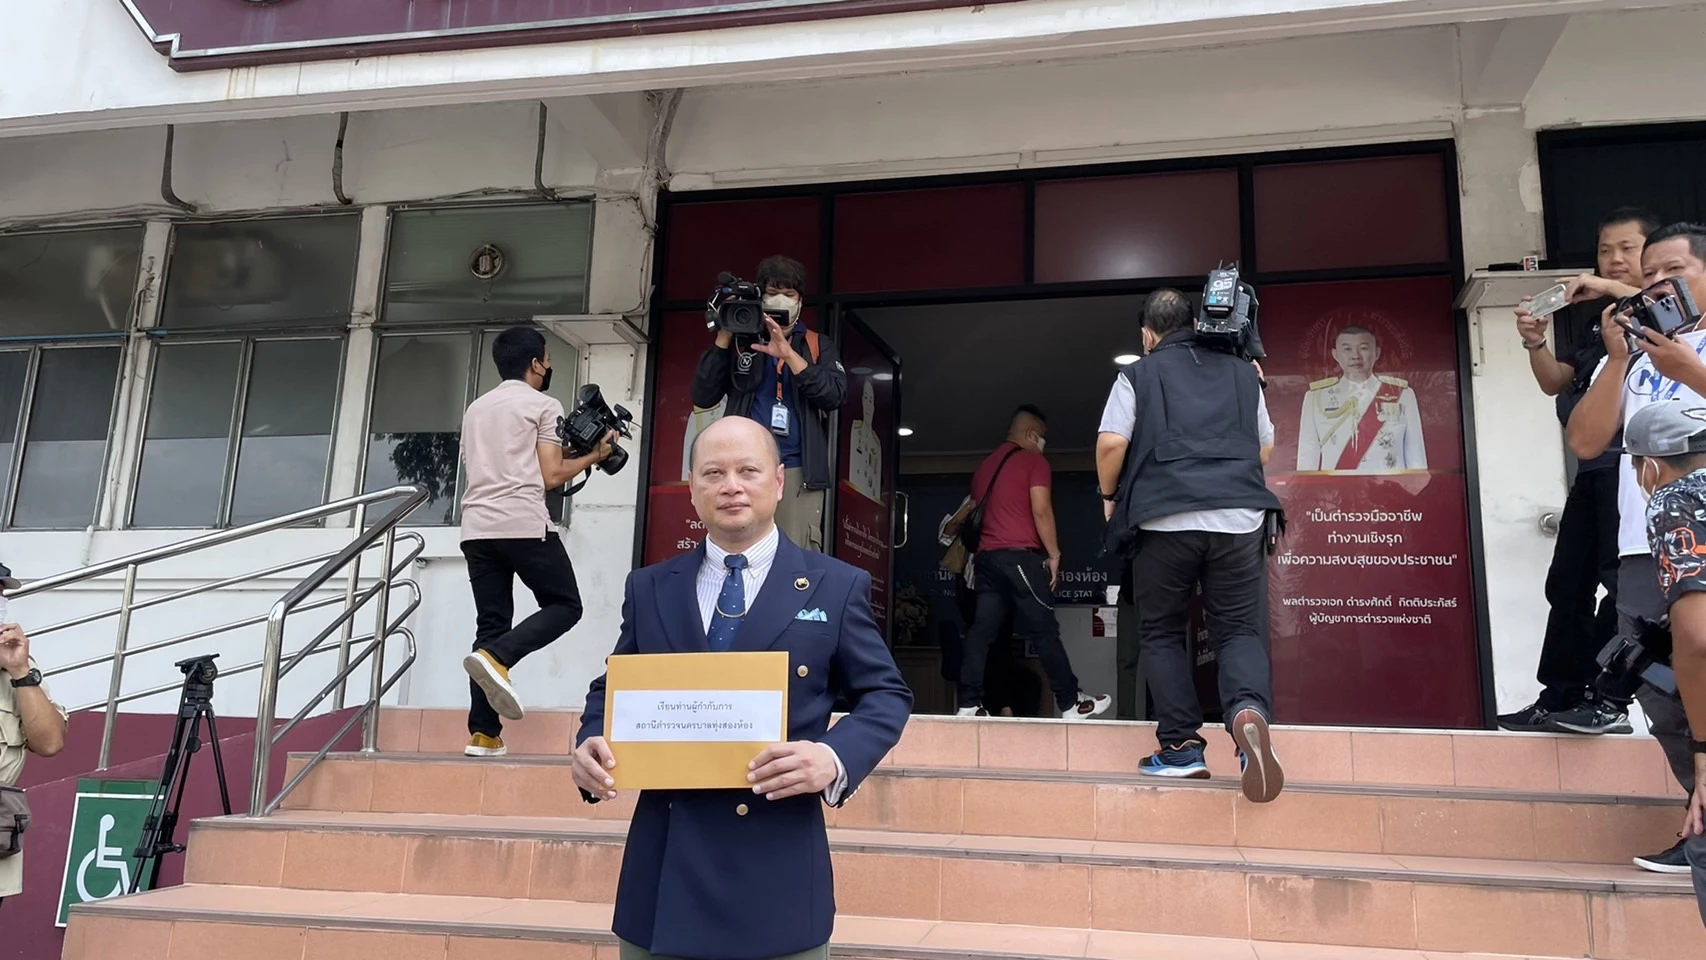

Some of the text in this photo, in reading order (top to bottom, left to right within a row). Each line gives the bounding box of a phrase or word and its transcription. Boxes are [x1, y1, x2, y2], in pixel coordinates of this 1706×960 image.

[1306, 508, 1423, 522] "เป็นตำรวจมืออาชีพ
[676, 537, 699, 549] สร้า
[1327, 530, 1403, 547] ทำงานเชิงรุก
[1277, 550, 1458, 568] เพื่อความสงบสุขของประชาชน"
[1282, 595, 1458, 608] พลตำรวจเอก ดำรงศักดิ์ กิตติประภัสร์
[1309, 612, 1432, 625] ผู้บัญชาการตำรวจแห่งชาติ
[657, 701, 733, 714] เรียนท่านผู้กำกับการ
[635, 719, 753, 733] สถานีตำรวจนครบาลทุ่งสองห้อง
